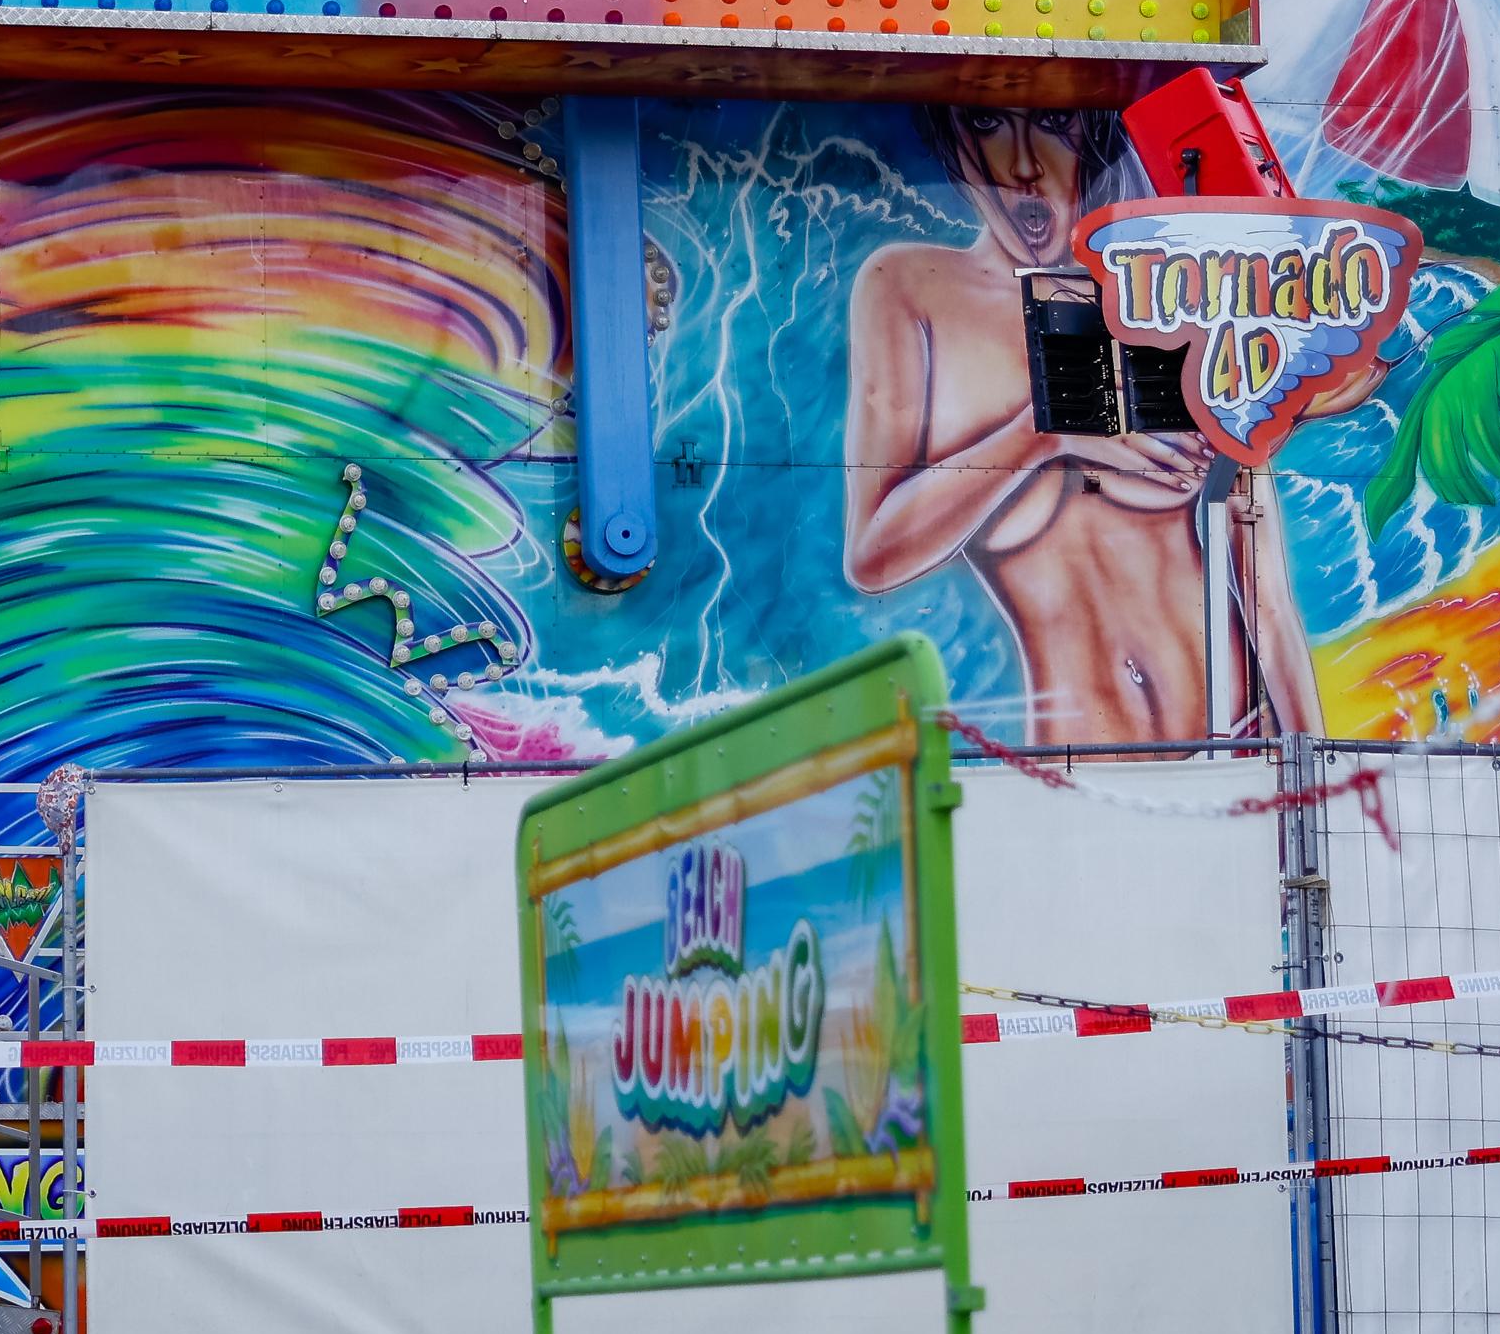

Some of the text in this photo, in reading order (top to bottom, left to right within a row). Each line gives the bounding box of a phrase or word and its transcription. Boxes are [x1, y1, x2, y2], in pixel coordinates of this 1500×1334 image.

[1108, 225, 1383, 326] Tornado
[1206, 320, 1280, 403] 4D
[666, 840, 744, 977] BEACH
[611, 918, 822, 1117] JUMPING
[101, 1218, 261, 1238] POLIZEIABSPERRUNG
[281, 1214, 442, 1230] POLIZEIABSPERRUNG
